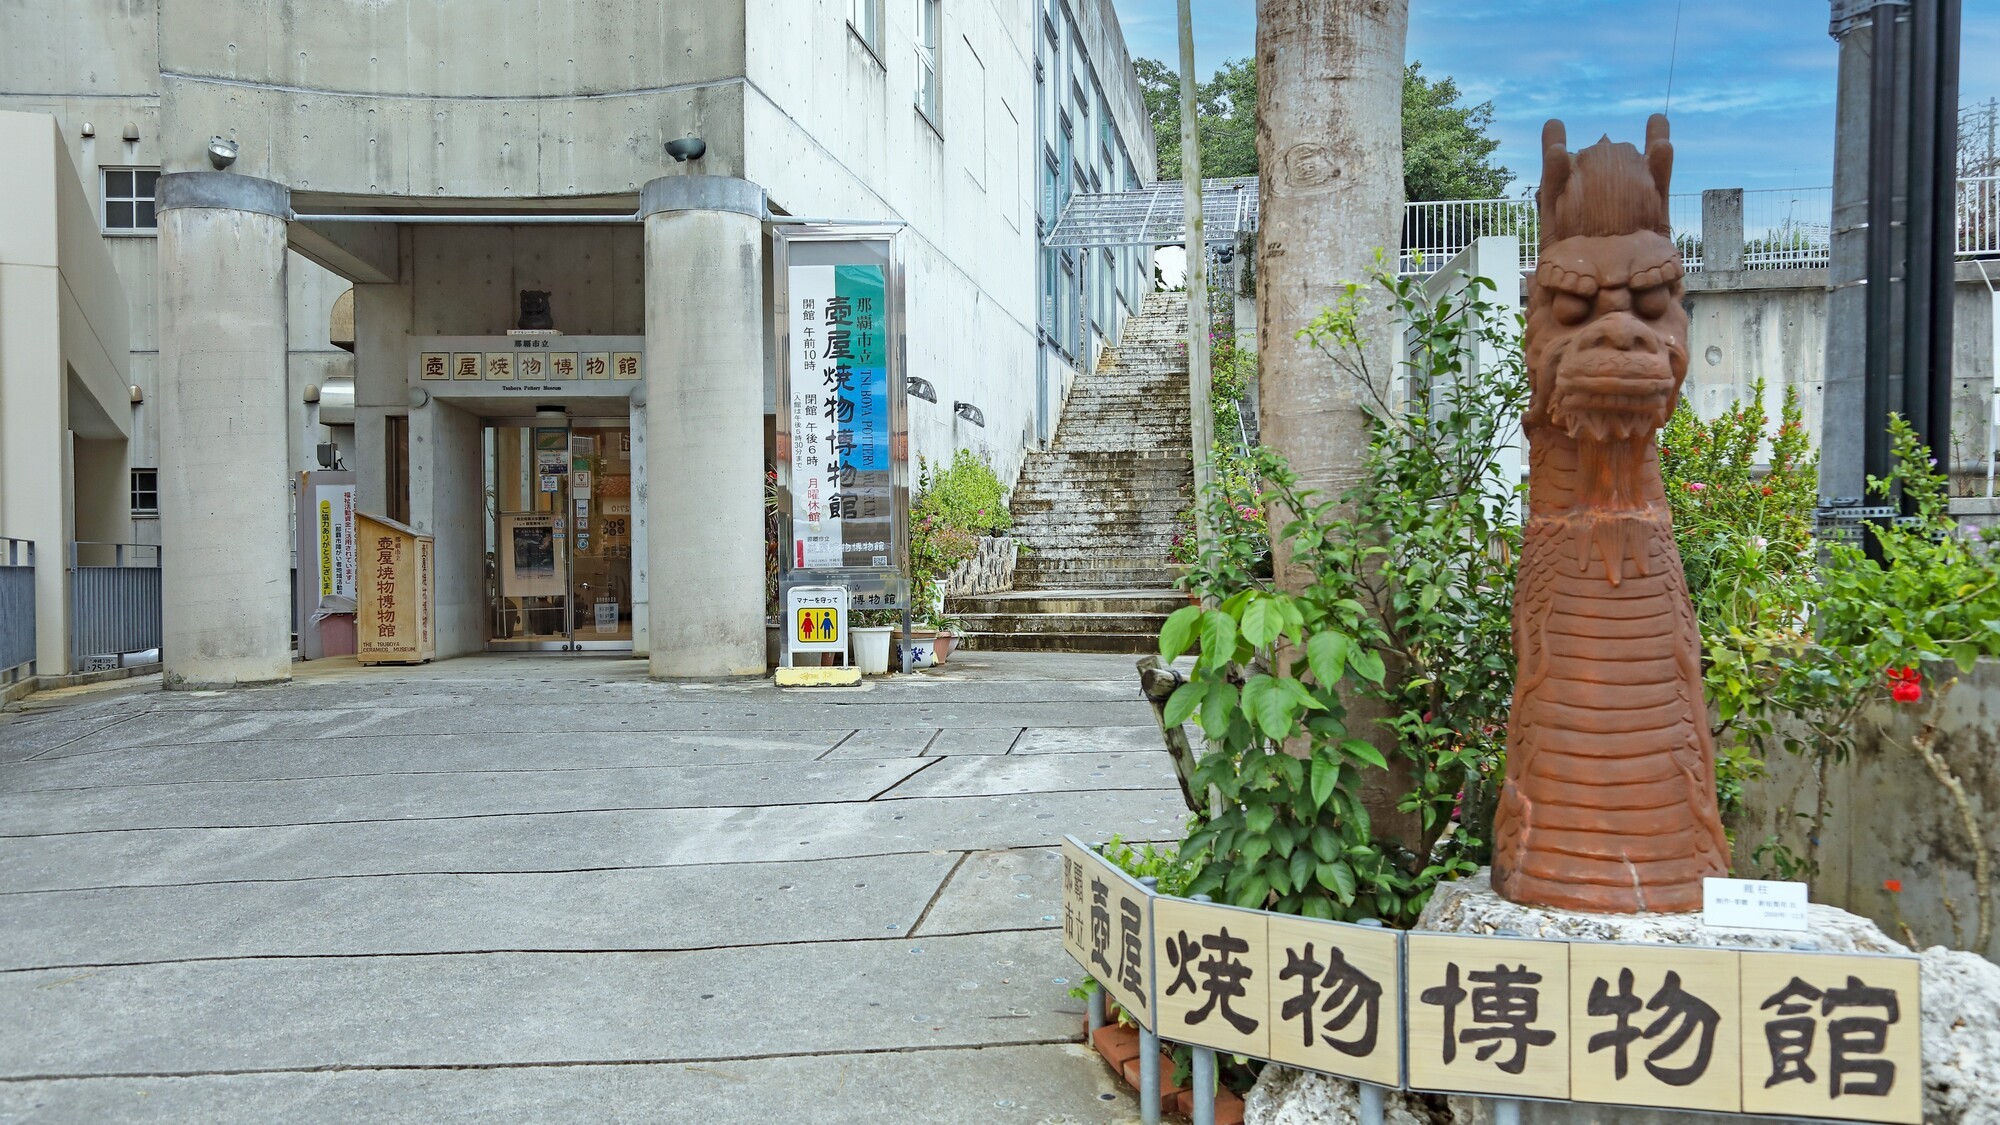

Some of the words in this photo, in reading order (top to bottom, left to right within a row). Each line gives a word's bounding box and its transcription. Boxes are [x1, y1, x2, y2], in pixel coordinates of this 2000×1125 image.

[802, 298, 815, 321] 開館
[856, 297, 873, 365] 那覇市立
[513, 340, 549, 348] 那覇市立
[803, 327, 817, 372] 午前10時
[805, 393, 818, 416] 閉館
[860, 369, 873, 417] TSUBOYA
[805, 422, 818, 467] 午後6時
[862, 420, 874, 468] POTTERY
[807, 478, 821, 522] 月曜休館
[862, 473, 876, 517] MUSEUM
